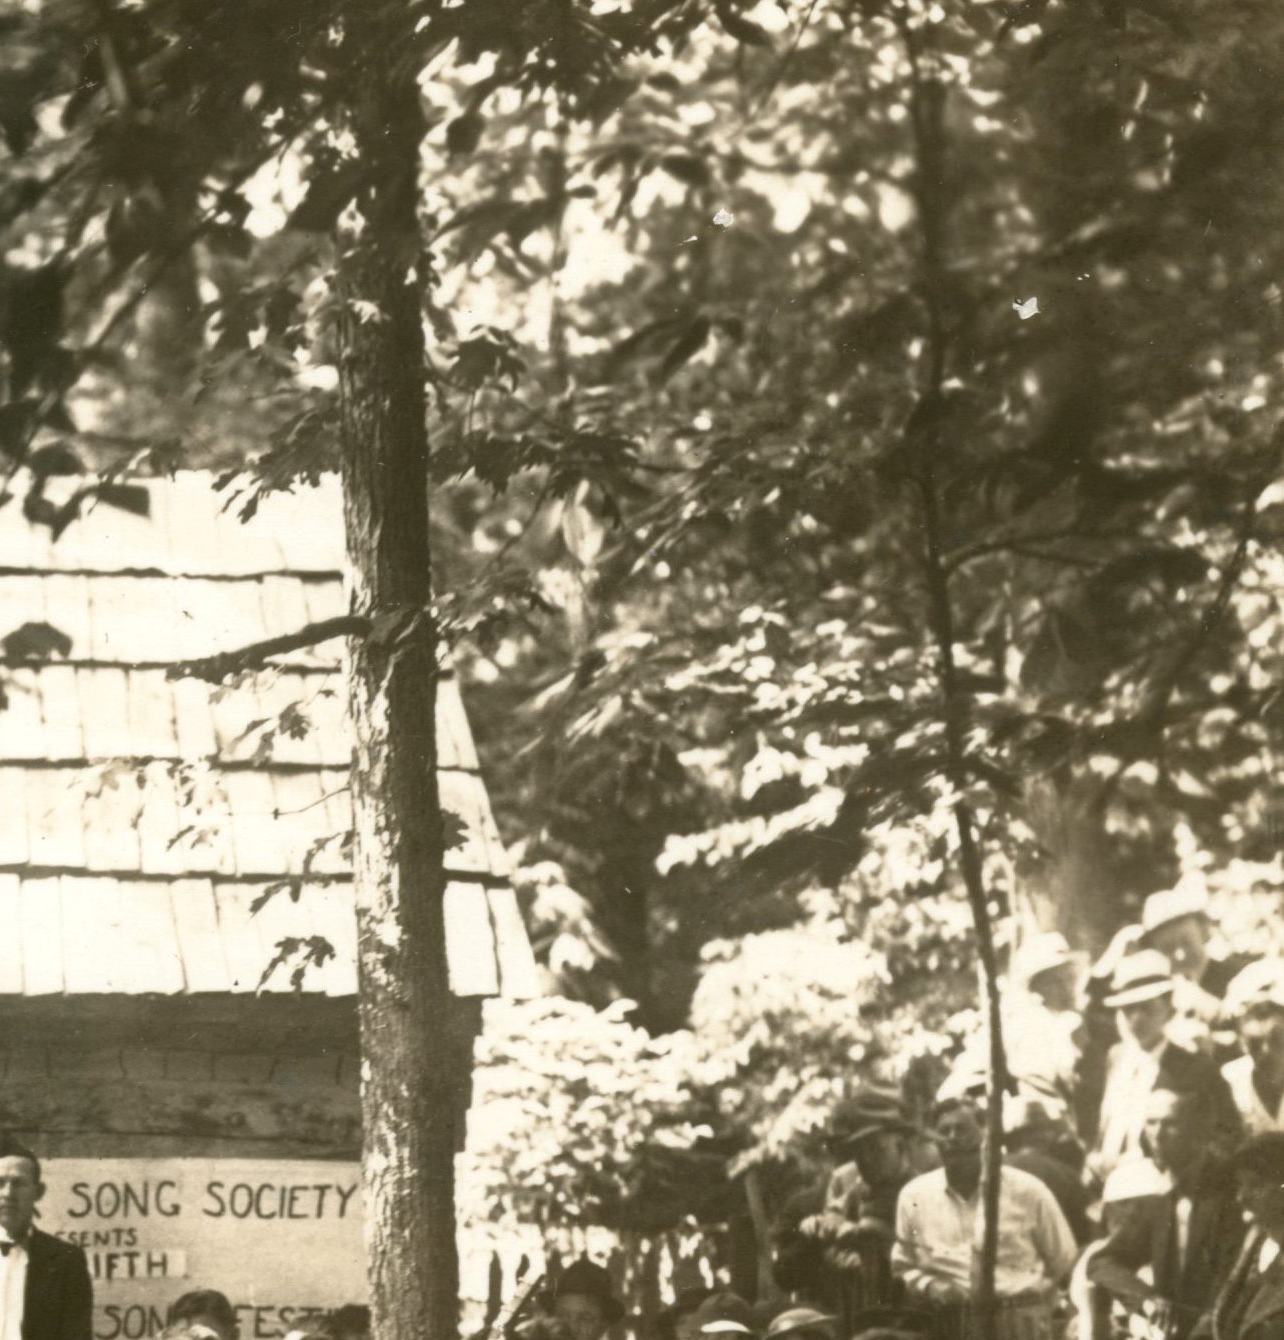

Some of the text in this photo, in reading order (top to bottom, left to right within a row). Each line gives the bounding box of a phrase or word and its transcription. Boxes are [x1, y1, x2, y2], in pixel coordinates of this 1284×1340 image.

[67, 1181, 181, 1220] SONG
[202, 1181, 359, 1220] SOCIETY
[93, 1251, 168, 1280] IFTH
[95, 1304, 175, 1340] SON
